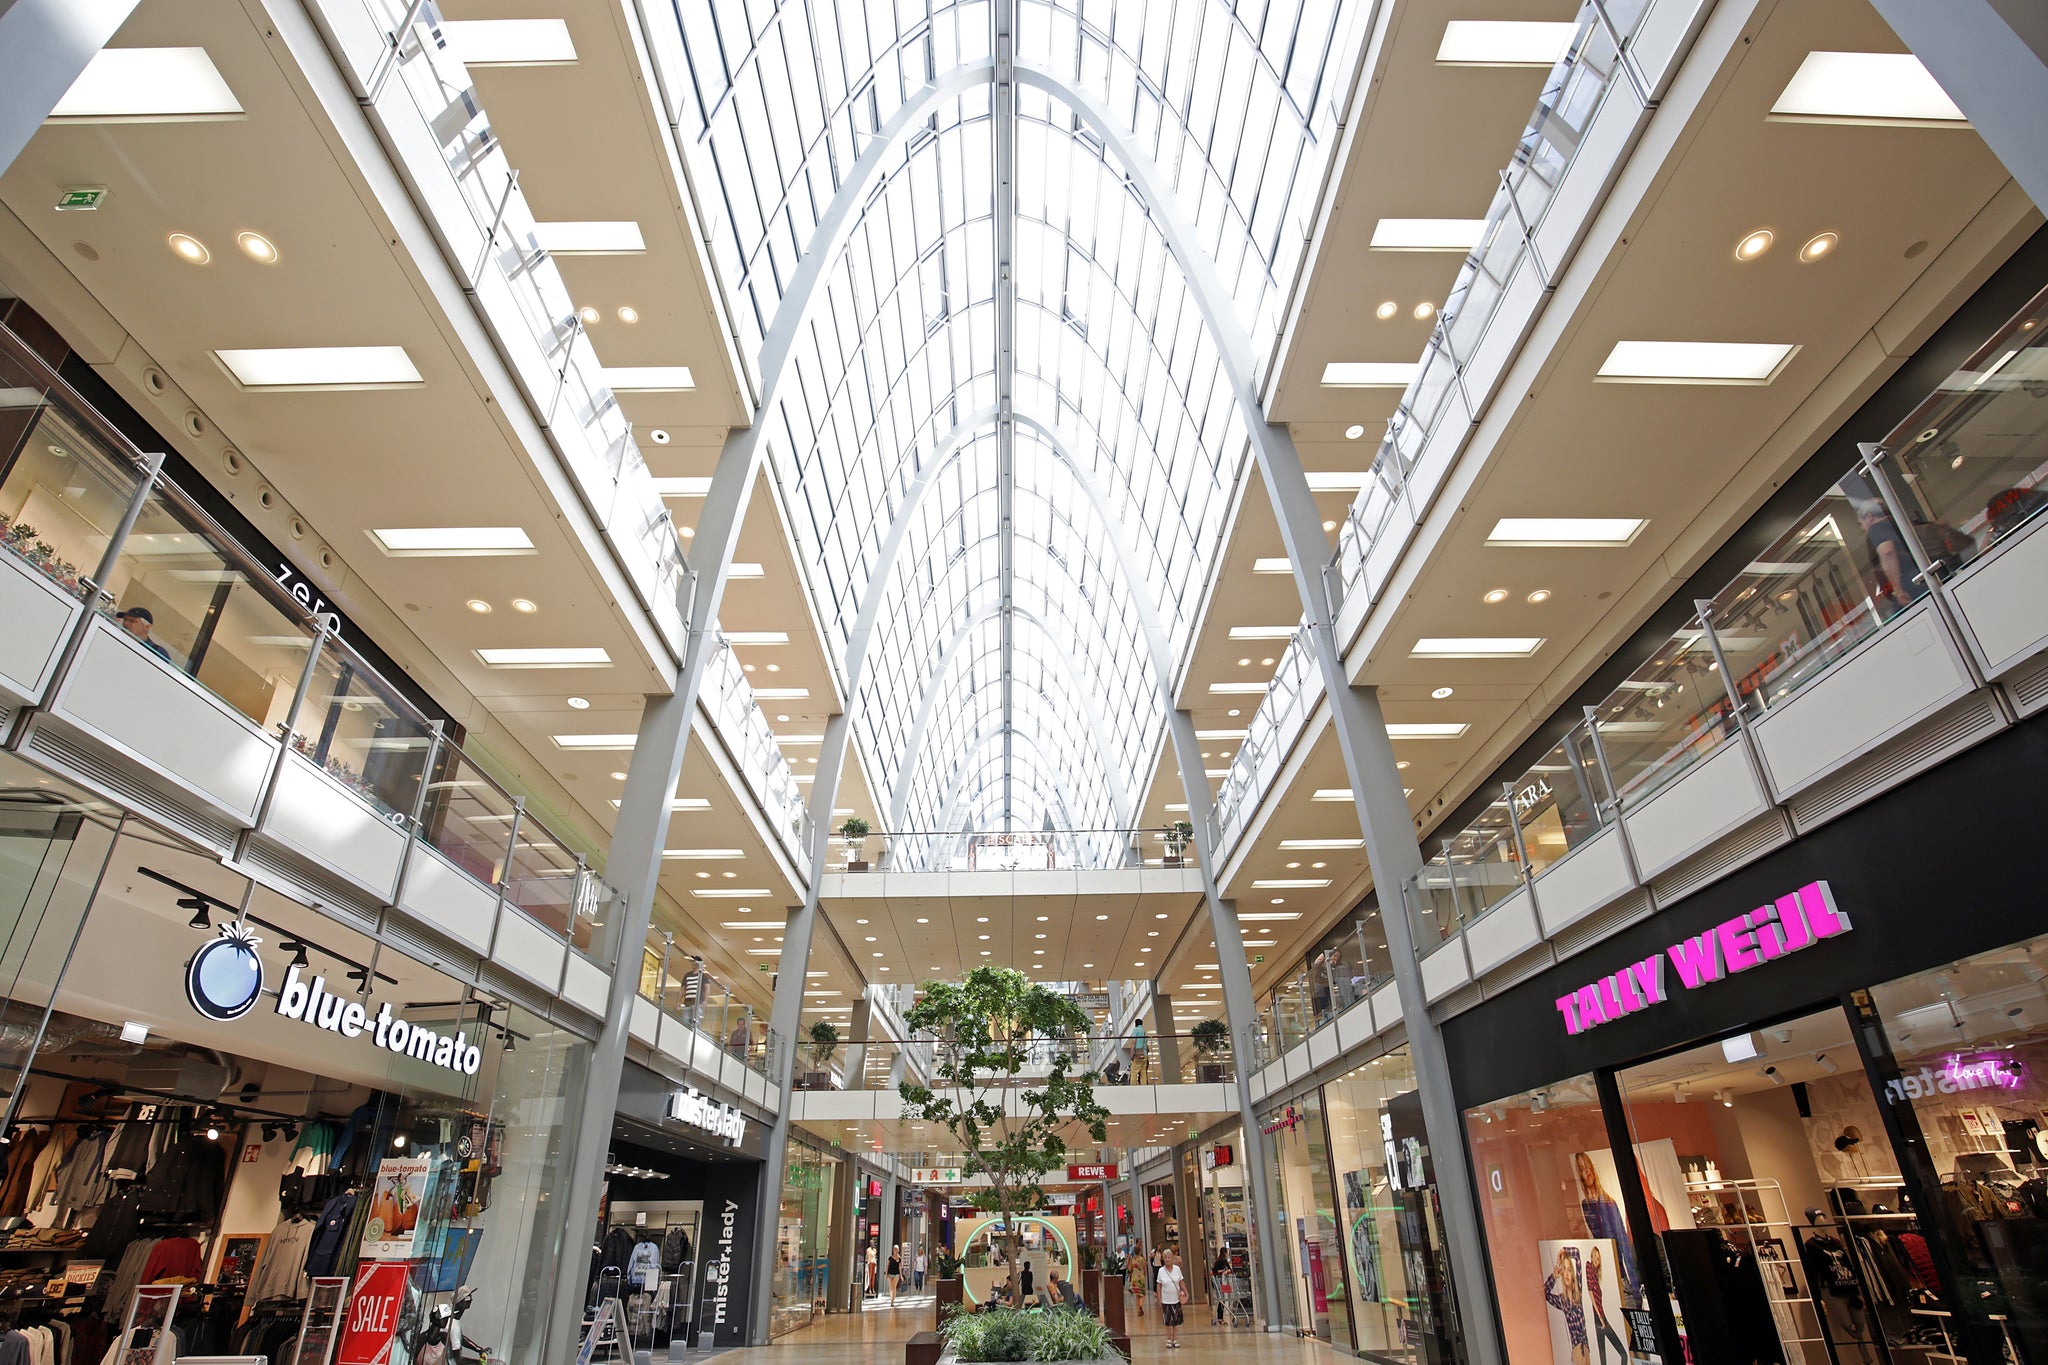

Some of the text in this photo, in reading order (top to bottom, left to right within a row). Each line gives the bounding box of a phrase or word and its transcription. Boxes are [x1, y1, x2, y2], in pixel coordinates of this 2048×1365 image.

[276, 563, 341, 635] zero
[275, 966, 480, 1075] blue-tomato
[1555, 954, 1667, 1035] TALLY
[381, 1164, 427, 1173] blue-tomato
[1078, 1167, 1105, 1176] REWE
[352, 1296, 395, 1333] SALE
